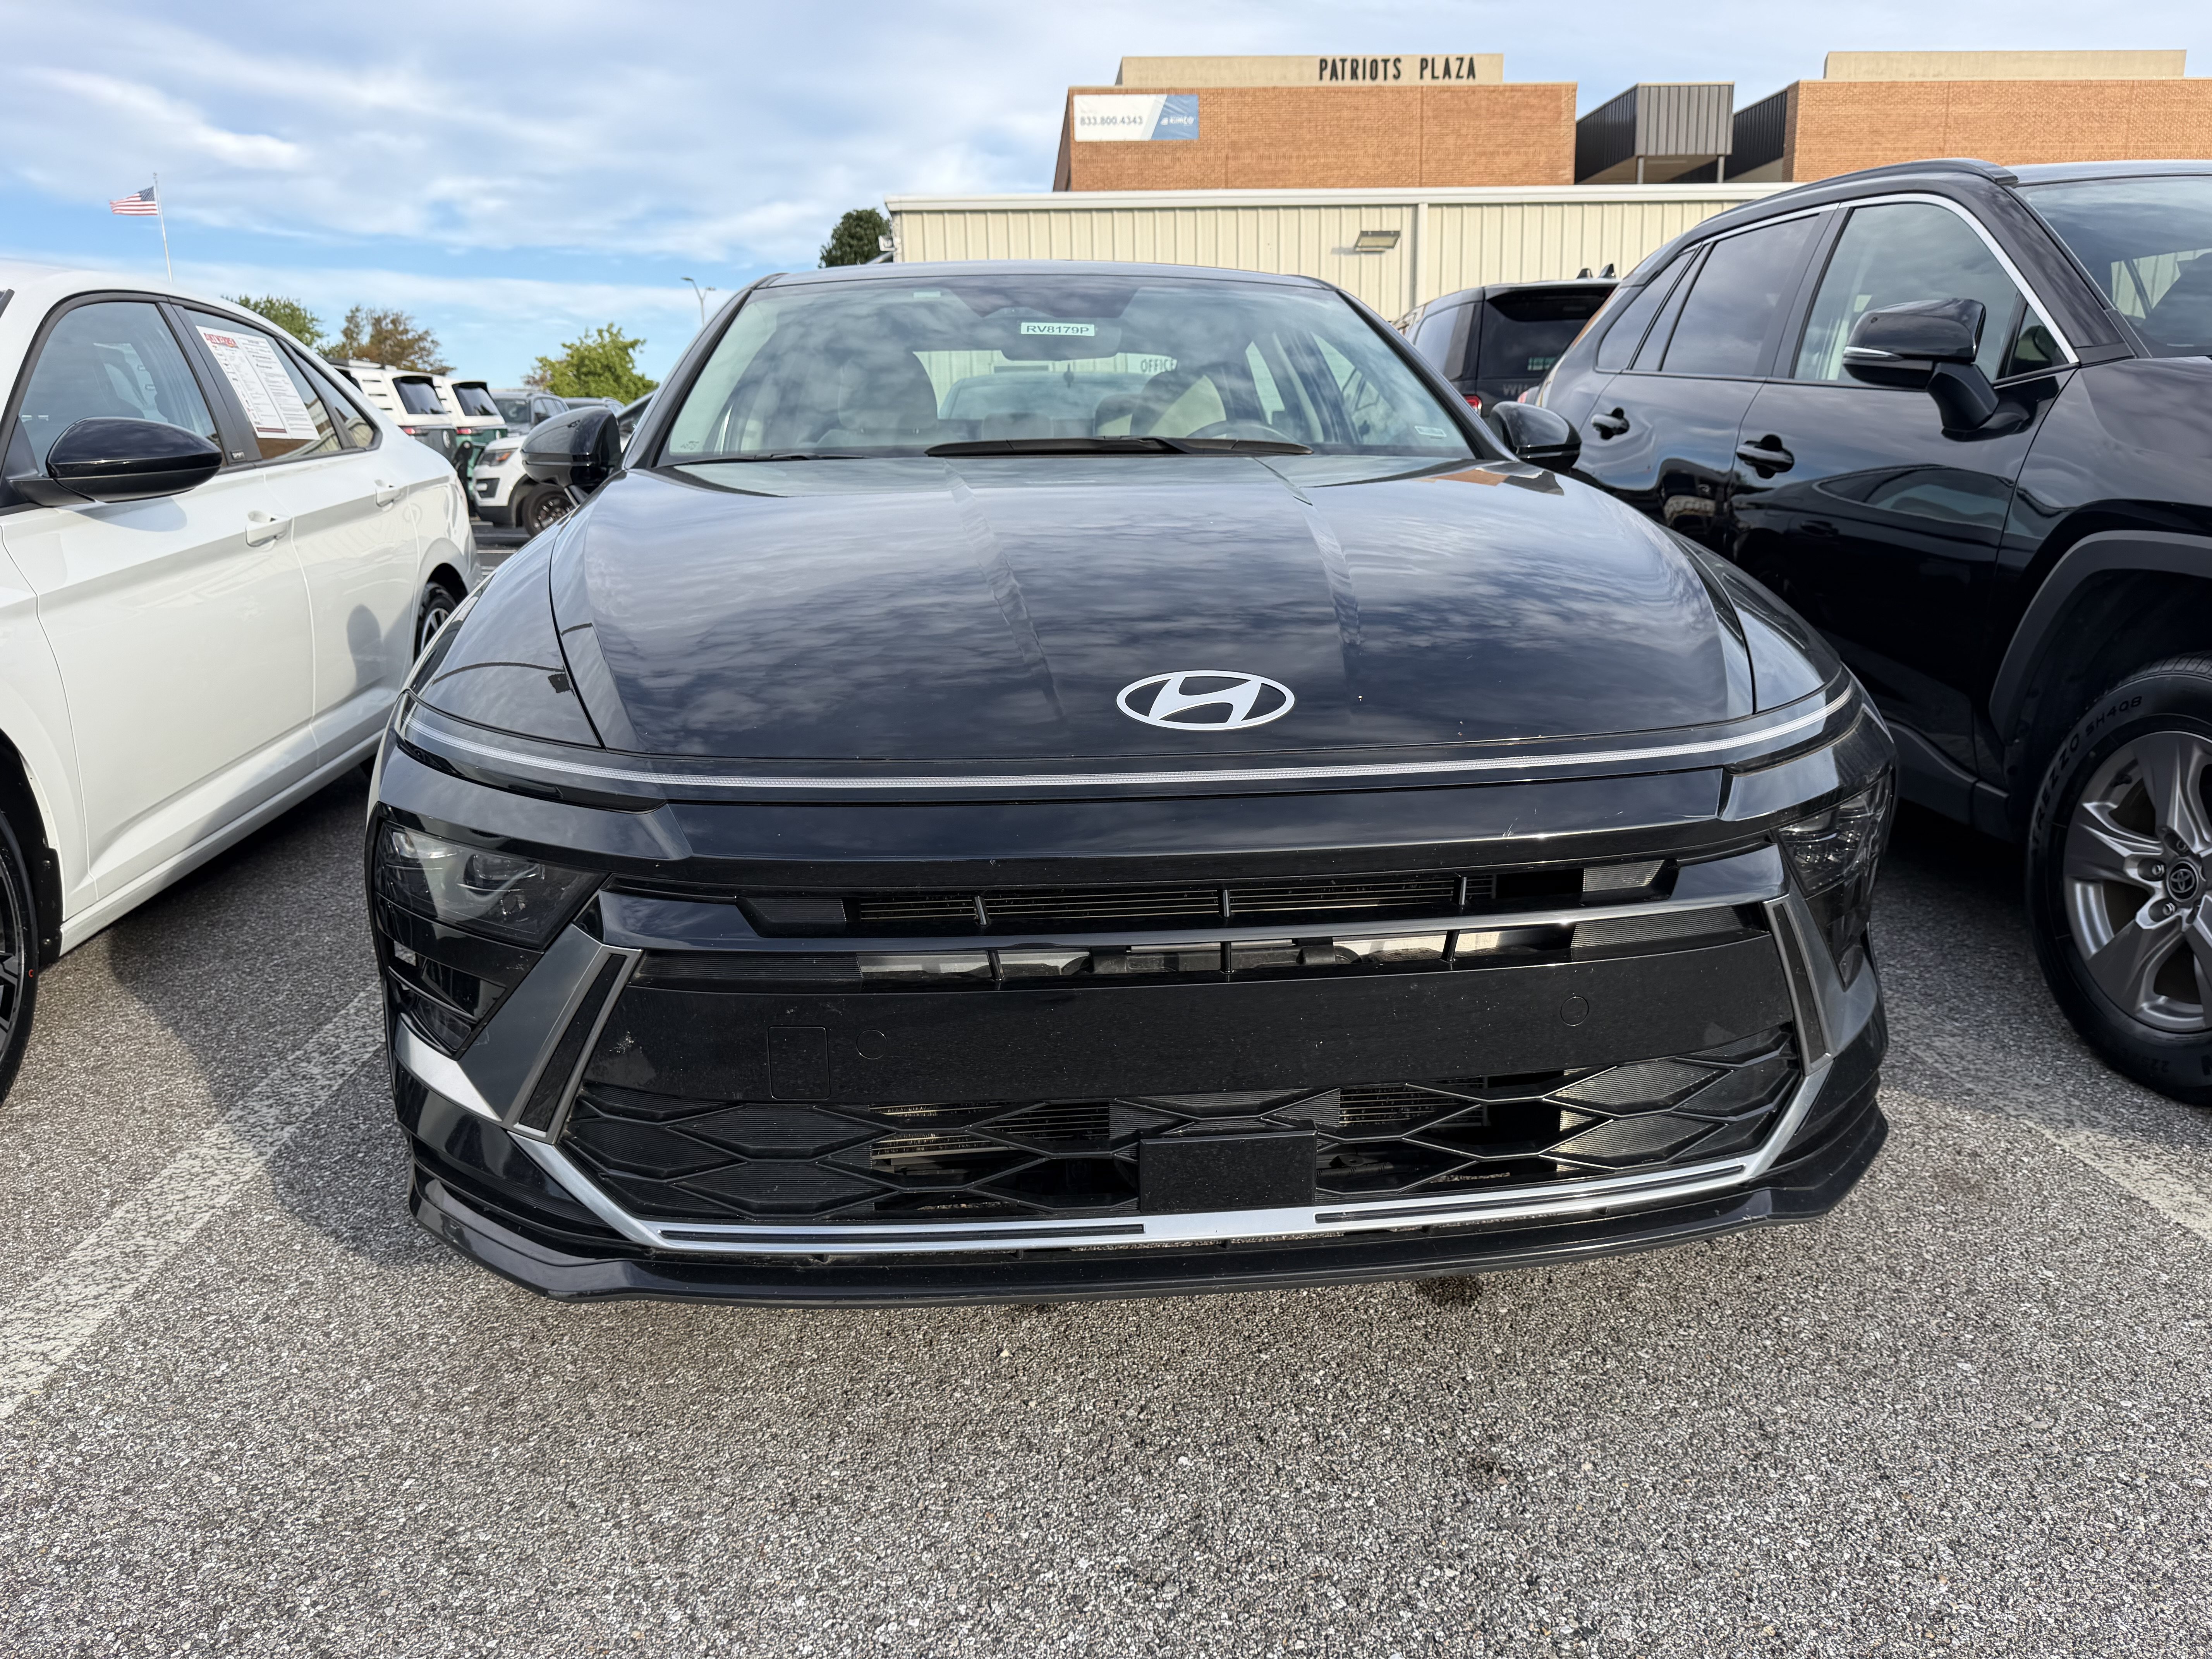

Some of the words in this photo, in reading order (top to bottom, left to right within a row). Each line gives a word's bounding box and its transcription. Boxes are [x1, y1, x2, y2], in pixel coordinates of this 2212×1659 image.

[1319, 58, 1401, 81] PATRIOTS
[1420, 57, 1476, 80] PLAZA
[1026, 325, 1089, 334] RV8179P
[2085, 696, 2142, 737] SH408
